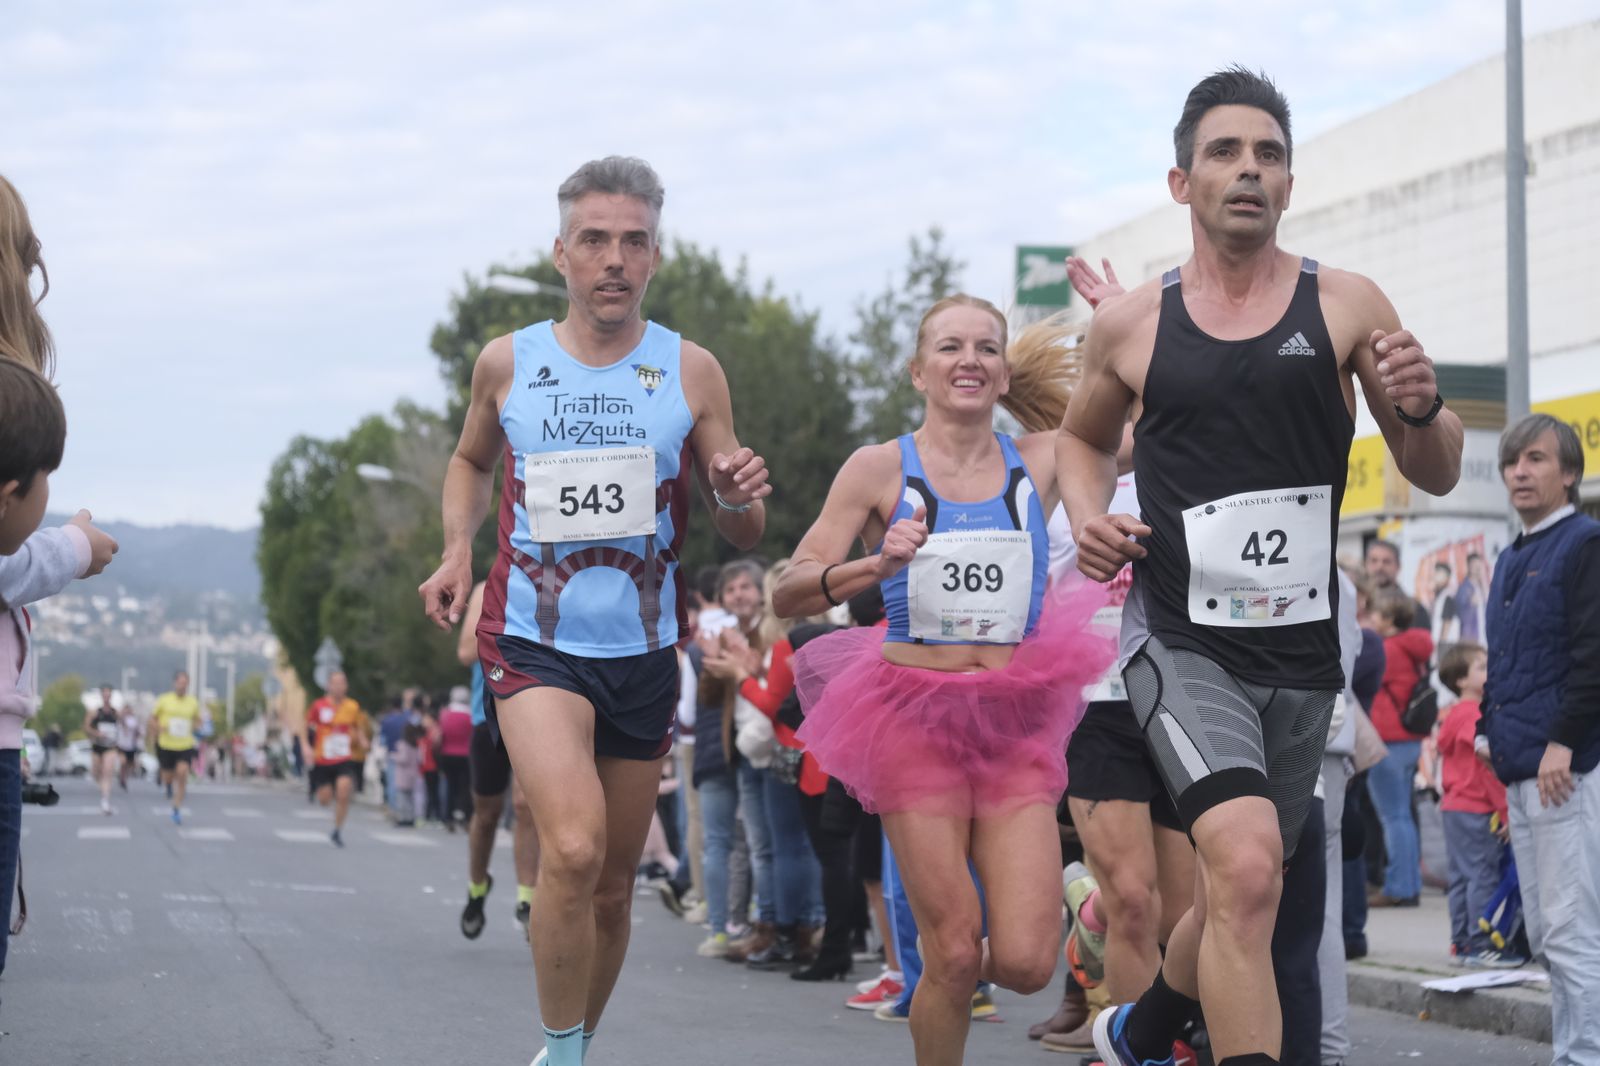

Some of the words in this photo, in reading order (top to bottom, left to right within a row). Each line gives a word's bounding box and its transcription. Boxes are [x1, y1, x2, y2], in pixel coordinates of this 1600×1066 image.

[1278, 347, 1316, 356] adidas
[528, 378, 560, 390] VIATOR
[558, 456, 599, 465] SILVESTRE
[601, 453, 649, 463] CORDOBESA
[560, 483, 625, 517] 543
[1225, 496, 1273, 508] SILVESTRE
[1274, 492, 1324, 504] CORDESA
[1241, 529, 1289, 567] 42
[942, 562, 1003, 593] 369
